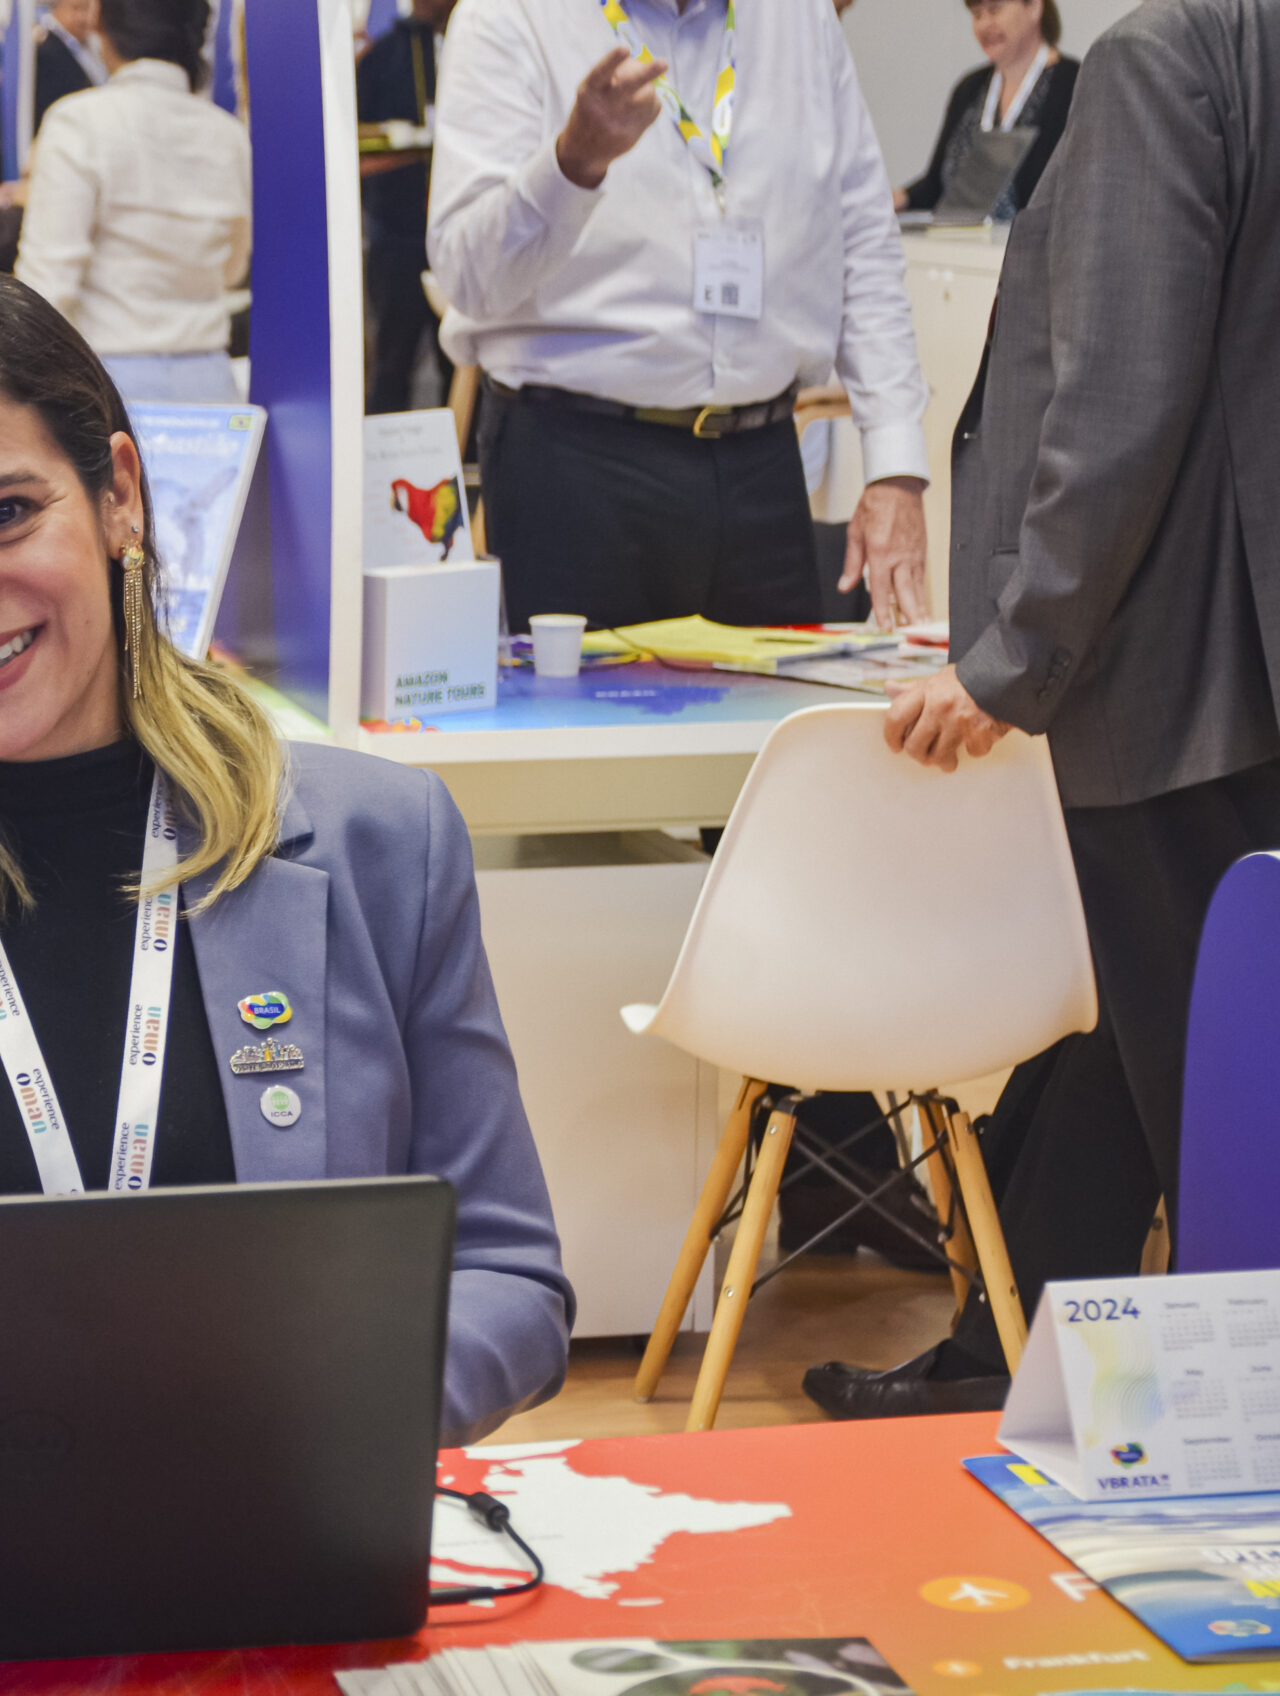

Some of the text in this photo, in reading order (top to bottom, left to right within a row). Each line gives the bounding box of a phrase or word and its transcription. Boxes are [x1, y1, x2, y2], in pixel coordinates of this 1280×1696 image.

[395, 683, 486, 705] NATURE TOURS
[396, 671, 449, 689] AMAZON
[153, 893, 172, 952] oman
[128, 1004, 143, 1066] experience
[141, 1006, 162, 1066] oman
[253, 1006, 281, 1014] BRASIL
[15, 1072, 48, 1134] oman
[32, 1068, 61, 1131] experience
[114, 1122, 130, 1191] experience
[126, 1123, 149, 1191] oman
[1064, 1298, 1141, 1323] 2024
[1003, 1649, 1151, 1670] Frankfurt
